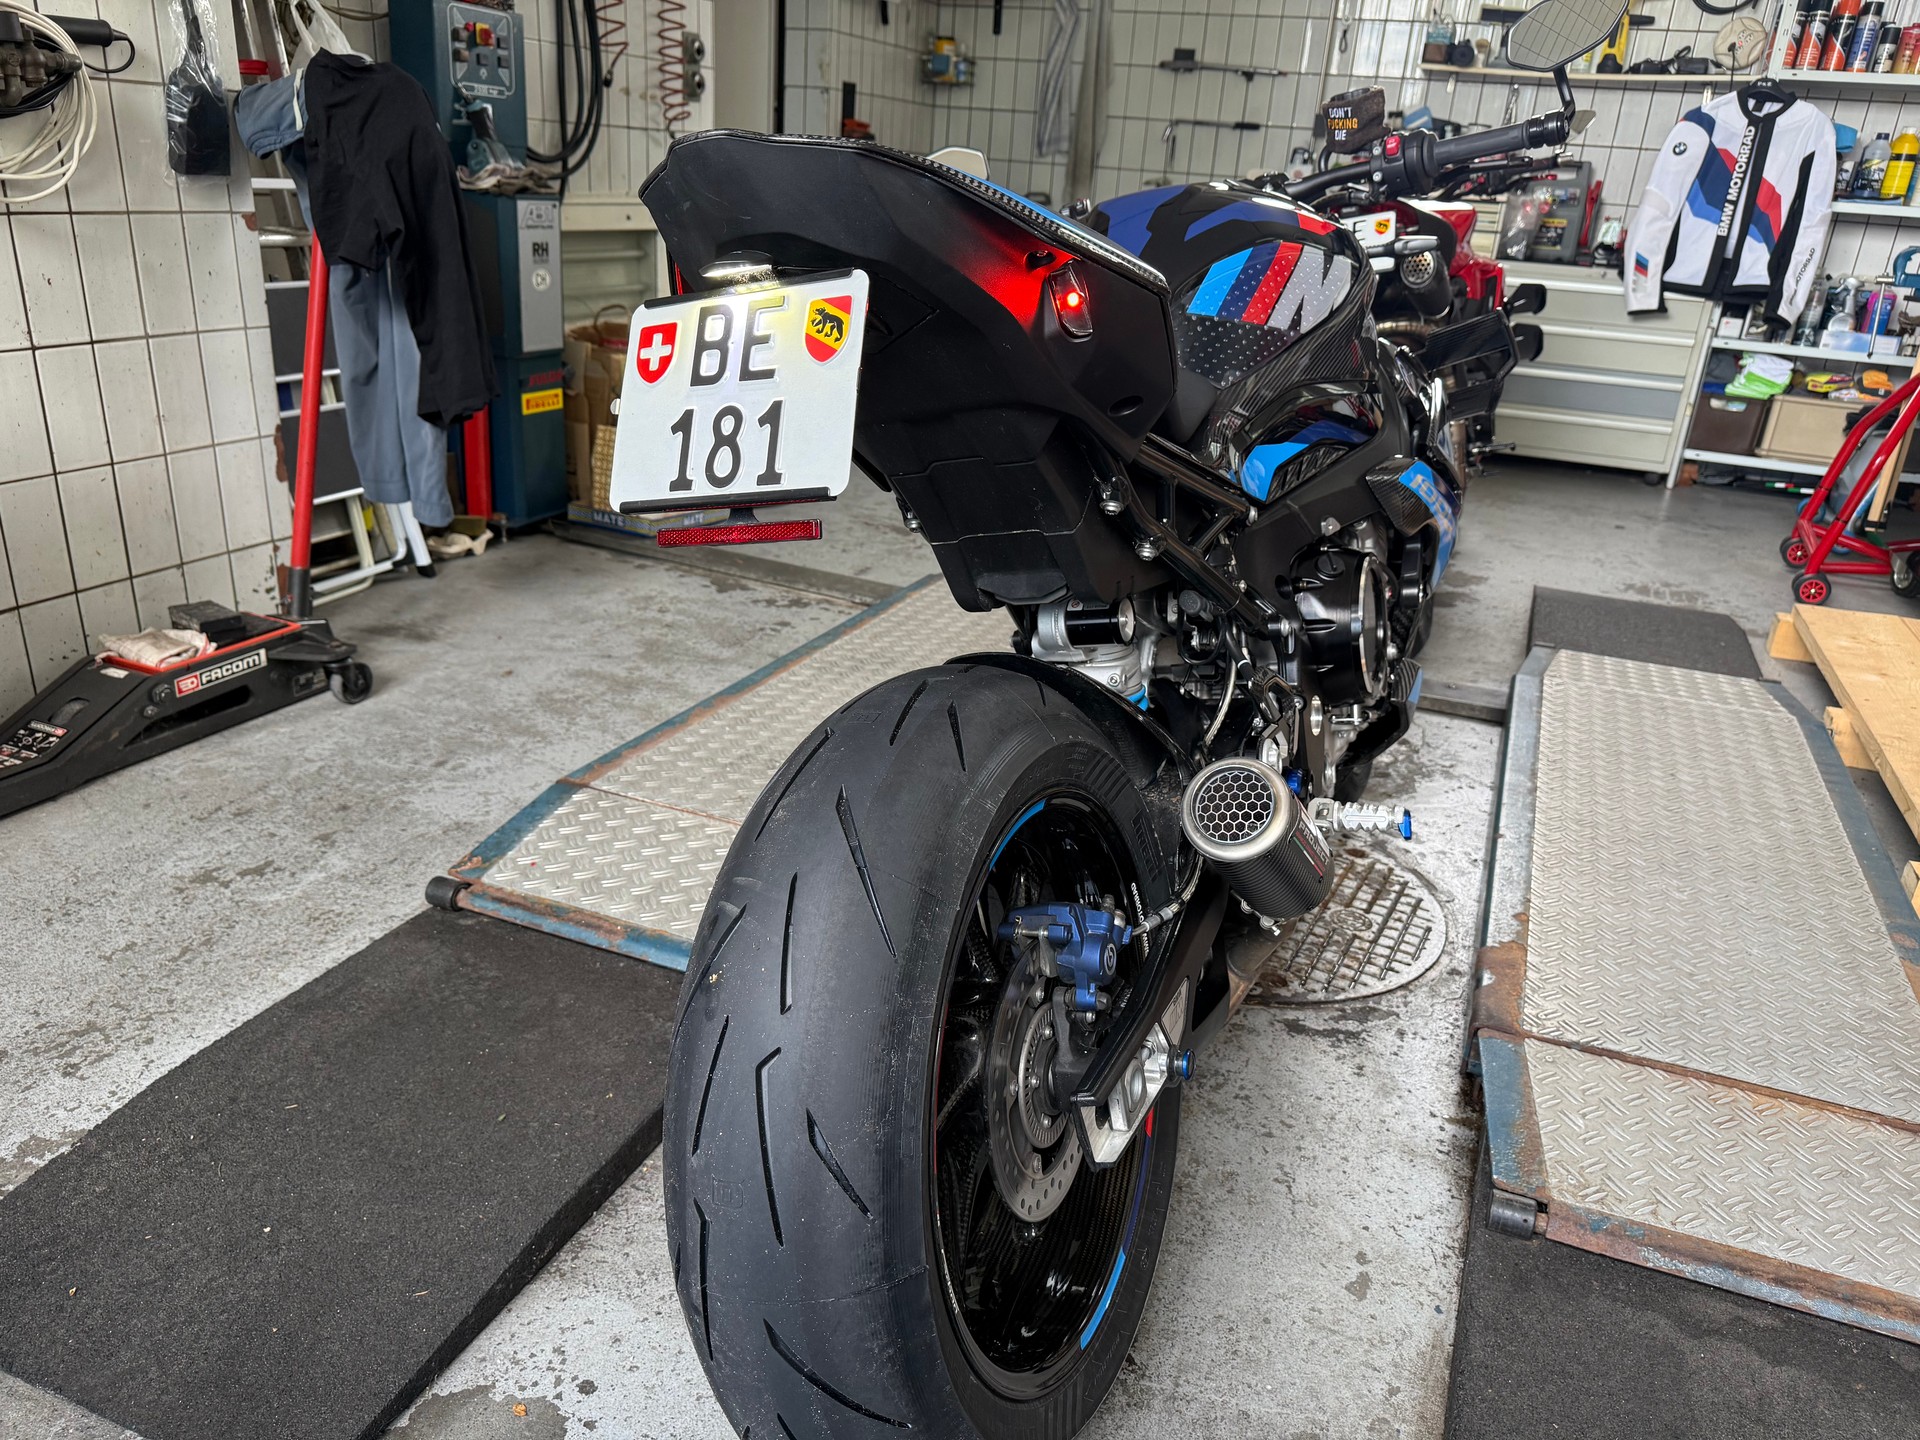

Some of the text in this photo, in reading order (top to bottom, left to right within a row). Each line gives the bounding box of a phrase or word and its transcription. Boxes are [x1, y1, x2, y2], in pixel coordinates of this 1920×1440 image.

[1327, 118, 1358, 130] FUCKING
[1328, 107, 1352, 118] DON'T
[1334, 130, 1347, 141] DIE
[1717, 126, 1755, 236] BMW MOTORRAD
[532, 242, 549, 257] RH
[690, 295, 786, 387] BE
[669, 399, 784, 493] 181
[201, 653, 261, 685] FACOM
[1298, 820, 1330, 866] PROJECT
[1130, 882, 1145, 923] OTORRAD
